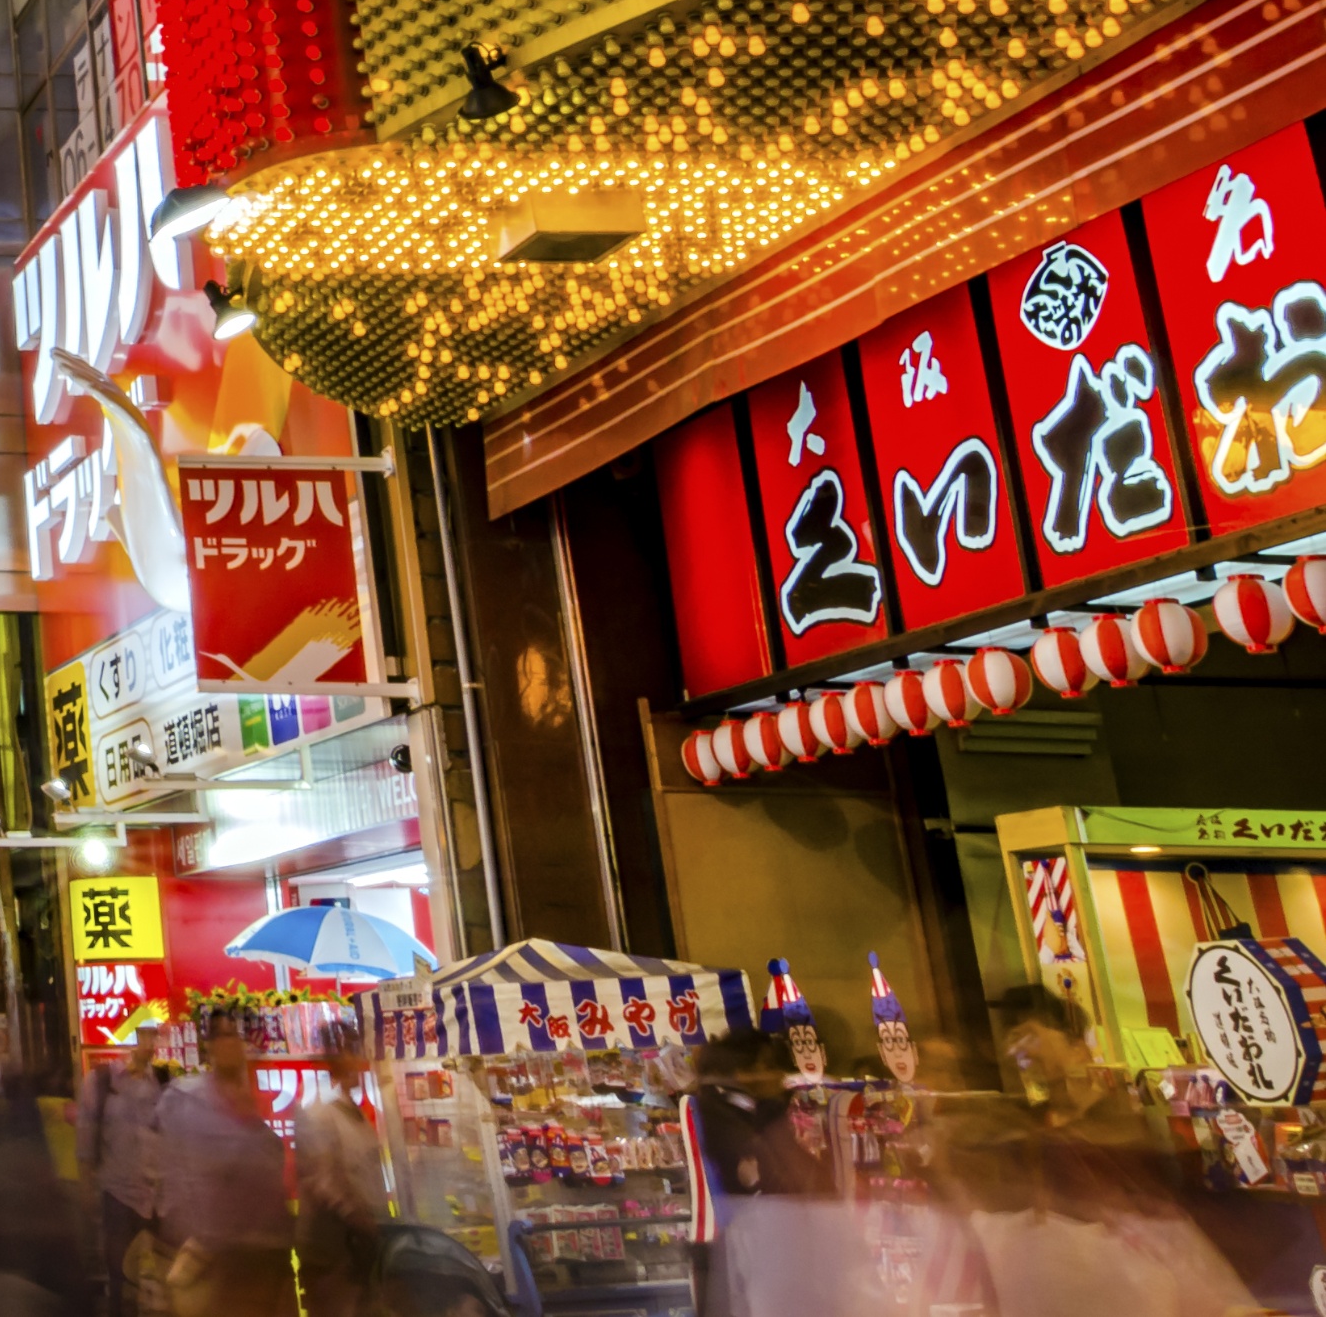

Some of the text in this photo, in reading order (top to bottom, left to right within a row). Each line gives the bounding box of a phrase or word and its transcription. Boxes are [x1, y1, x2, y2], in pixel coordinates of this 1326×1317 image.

[188, 479, 344, 527] ツルハ
[194, 537, 317, 571] ドラッグ
[98, 646, 138, 702] くすり
[164, 703, 222, 767] 道頓堀店
[1232, 817, 1326, 841] くいだ
[82, 887, 132, 949] 薬
[79, 964, 144, 996] ツルハ
[79, 997, 129, 1019] ドラッグ
[518, 990, 702, 1040] 大阪みやげ
[1212, 955, 1274, 1091] くいだおれ
